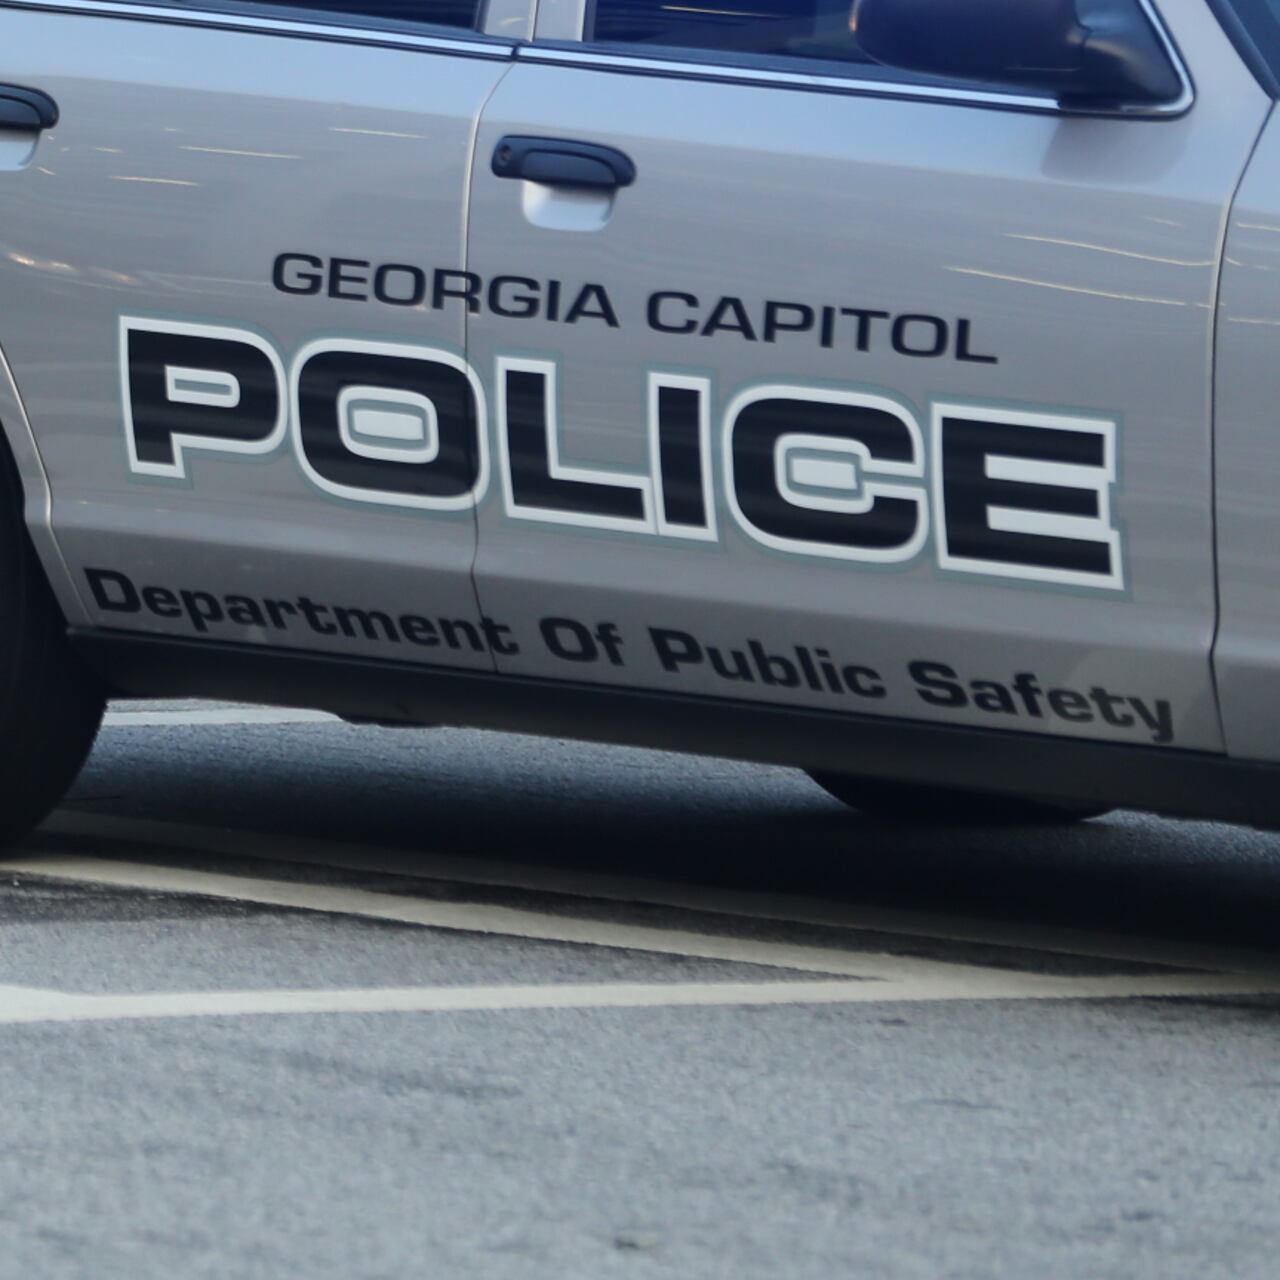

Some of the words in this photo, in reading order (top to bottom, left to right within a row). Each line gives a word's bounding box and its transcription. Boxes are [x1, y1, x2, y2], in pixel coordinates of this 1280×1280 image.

[272, 252, 619, 327] GEORGIA
[646, 290, 998, 364] CAPITOL
[118, 315, 1125, 591] POLICE
[83, 567, 519, 659] Department
[540, 614, 624, 666] Of
[651, 629, 887, 701] Public
[906, 660, 1175, 742] Safety
